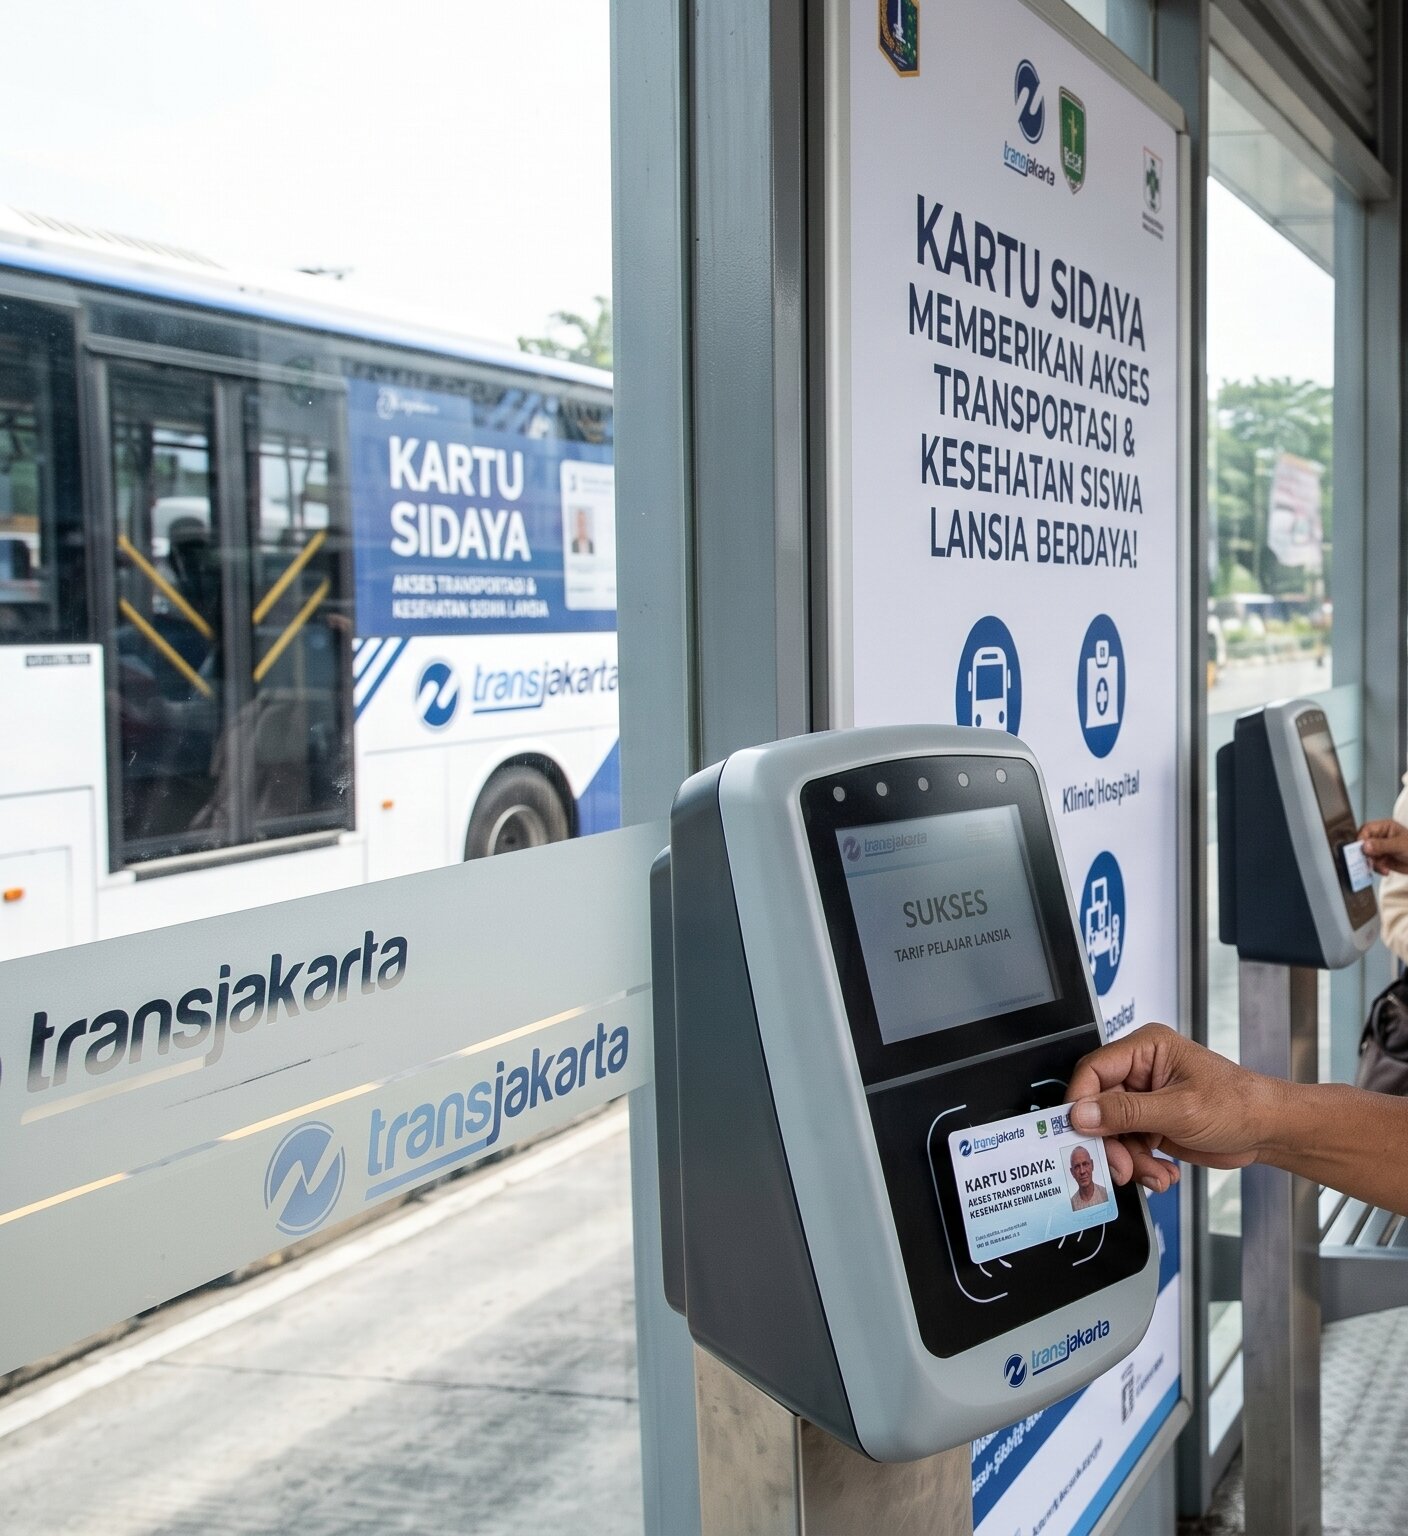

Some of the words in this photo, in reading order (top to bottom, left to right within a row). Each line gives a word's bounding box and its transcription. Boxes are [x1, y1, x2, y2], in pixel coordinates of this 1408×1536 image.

[917, 193, 1040, 308] KARTU
[1051, 259, 1146, 352] SIDAYA
[909, 282, 1083, 386] MEMBERIKAN
[1089, 350, 1150, 406] AKSES
[934, 363, 1117, 453] TRANSPORTASI
[1123, 417, 1135, 457] &
[389, 435, 523, 501] KARTU
[922, 433, 1074, 504] KESEHATAN
[1081, 465, 1143, 514] SISWA
[390, 501, 532, 562] SIDAYA
[931, 507, 1029, 562] LANSIA
[1037, 518, 1138, 568] BERDAYA!
[473, 659, 617, 706] transjakarta
[903, 889, 988, 928] SUKSES
[894, 945, 925, 962] TARIF
[927, 936, 973, 957] PELAJAR
[975, 928, 1012, 947] LANSIA
[26, 930, 408, 1093] transjakarta
[367, 1023, 630, 1178] transjakarta
[965, 1171, 1007, 1193] KARTU
[1010, 1159, 1055, 1181] SIDAYA:
[1031, 1320, 1110, 1370] transjakarta
